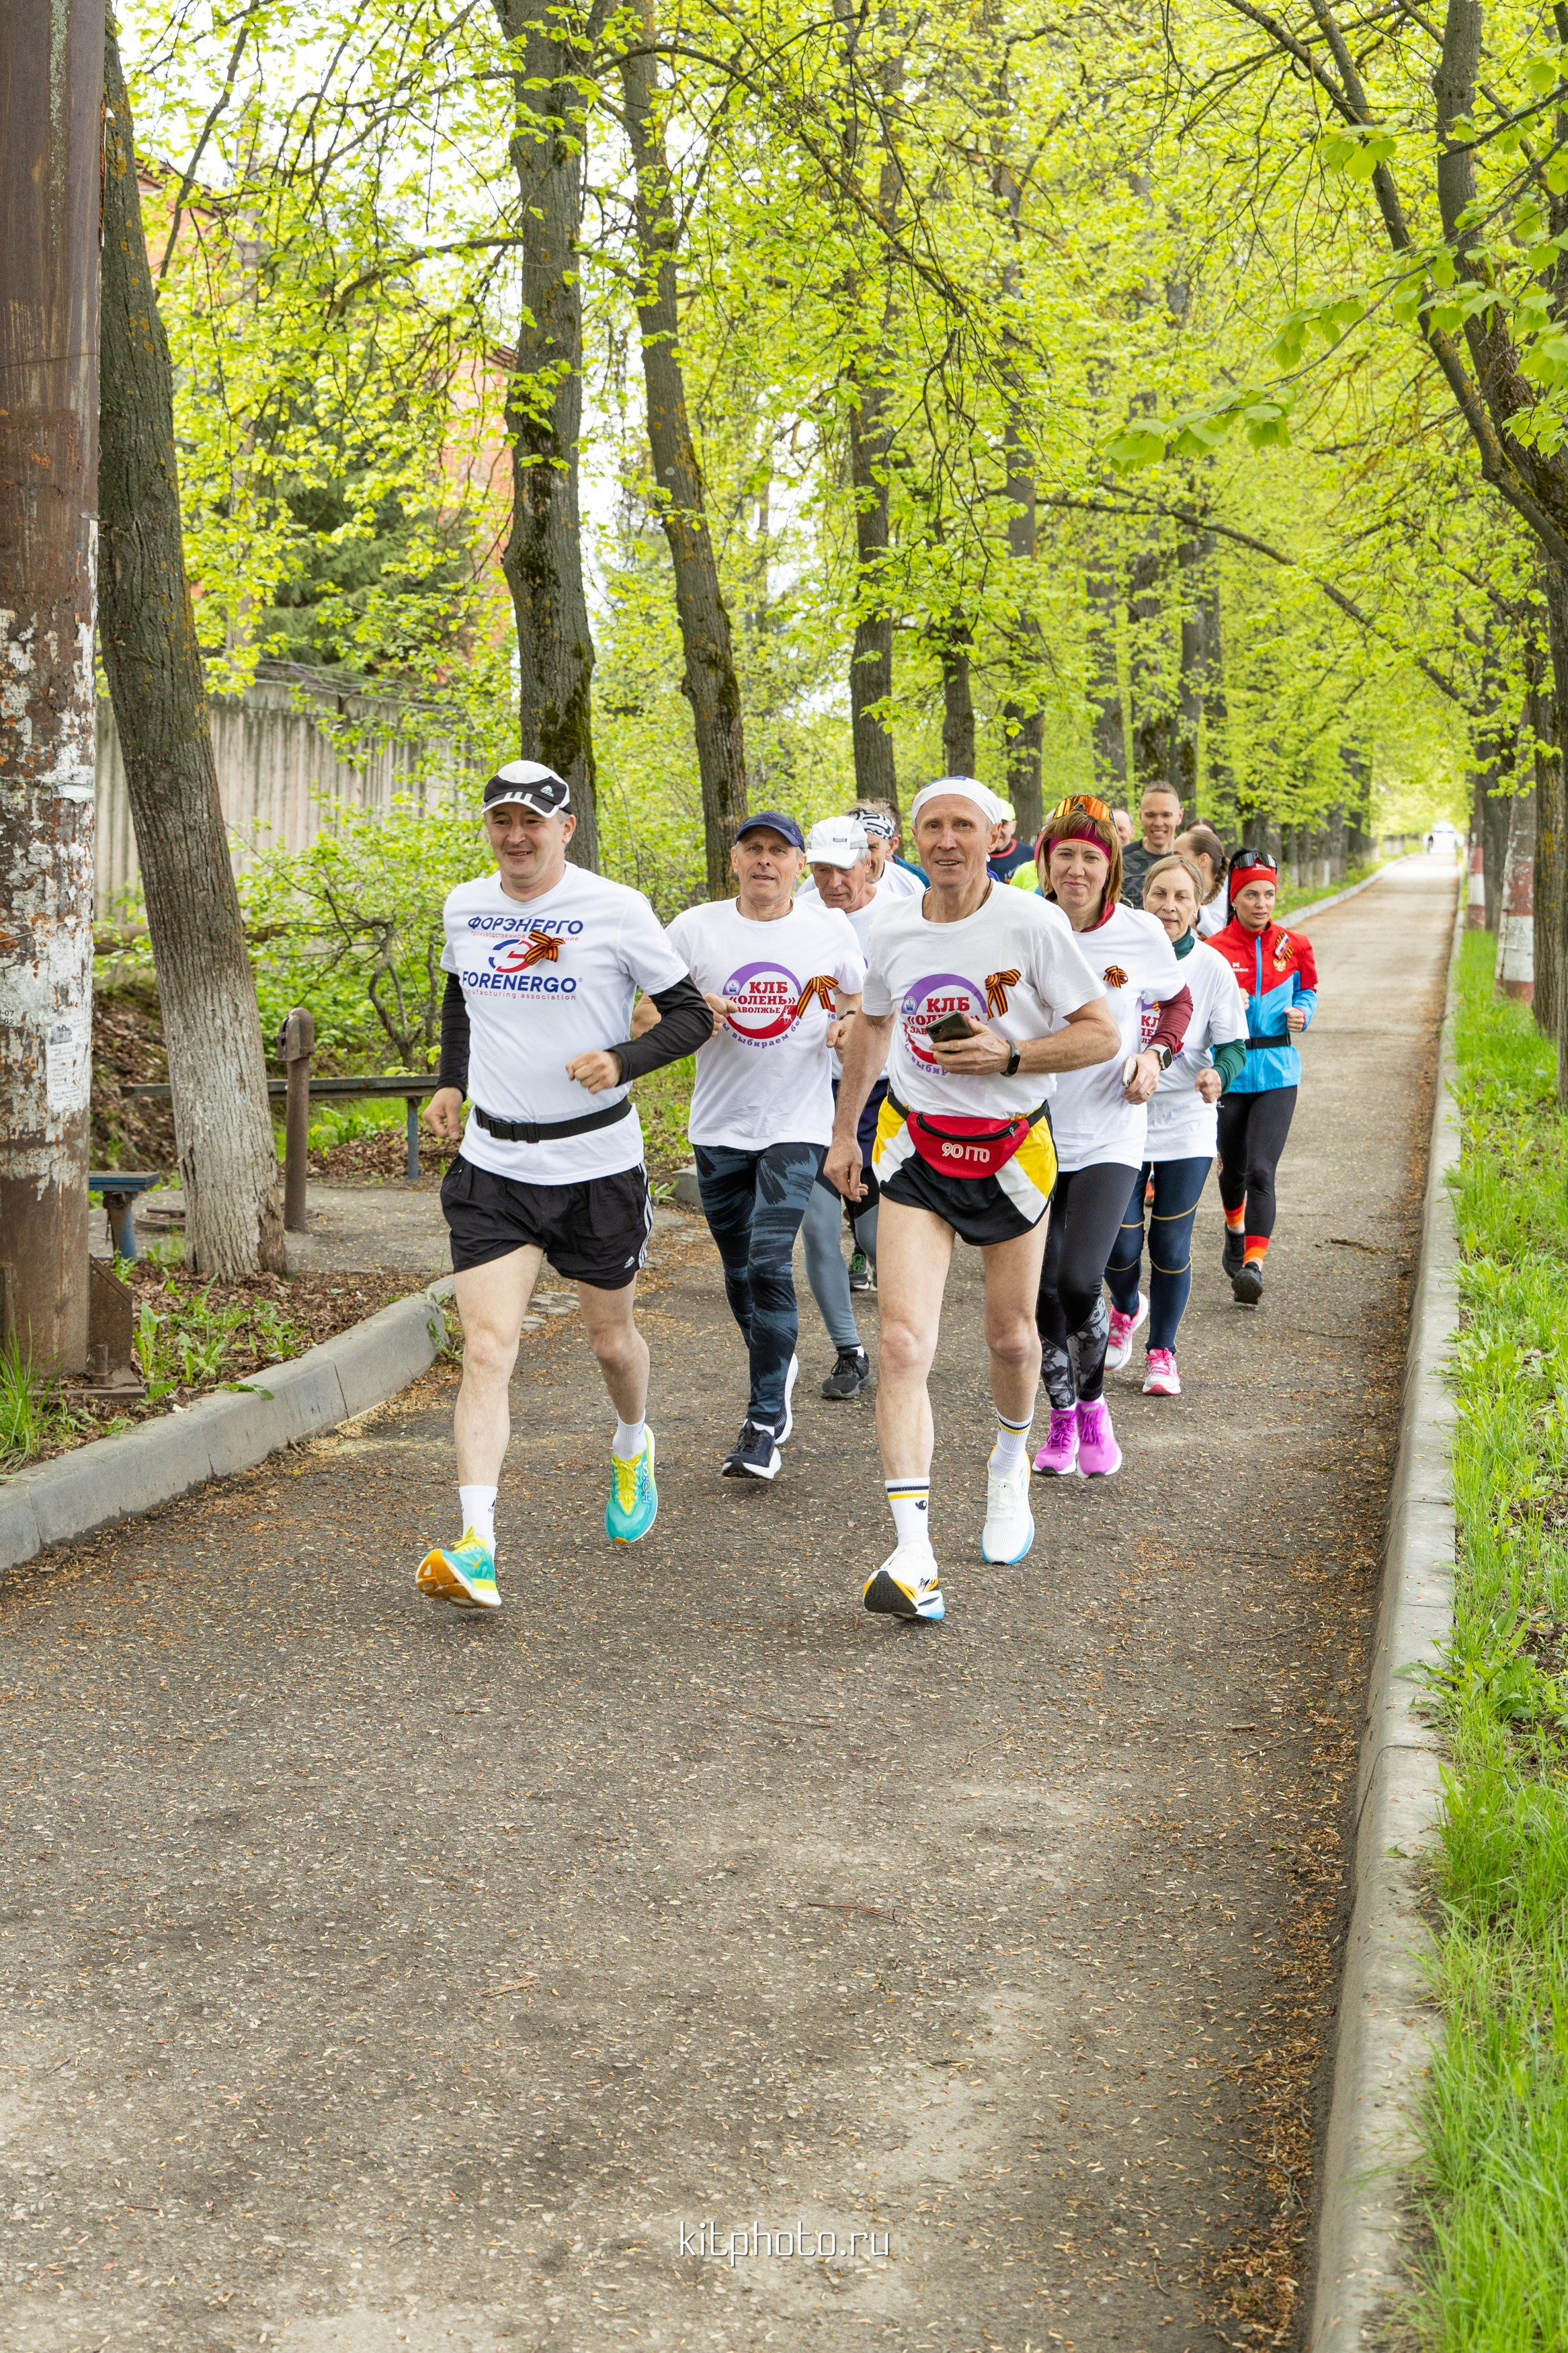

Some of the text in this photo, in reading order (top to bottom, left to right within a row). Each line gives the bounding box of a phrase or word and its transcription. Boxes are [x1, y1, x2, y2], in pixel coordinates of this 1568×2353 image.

[468, 916, 583, 934] ФОРЭНЕРГО
[749, 982, 788, 994] КЛБ
[926, 997, 971, 1013] КЛБ
[722, 1022, 730, 1032] ы
[732, 1031, 789, 1049] выбираем
[942, 1142, 990, 1163] 90 ГТО
